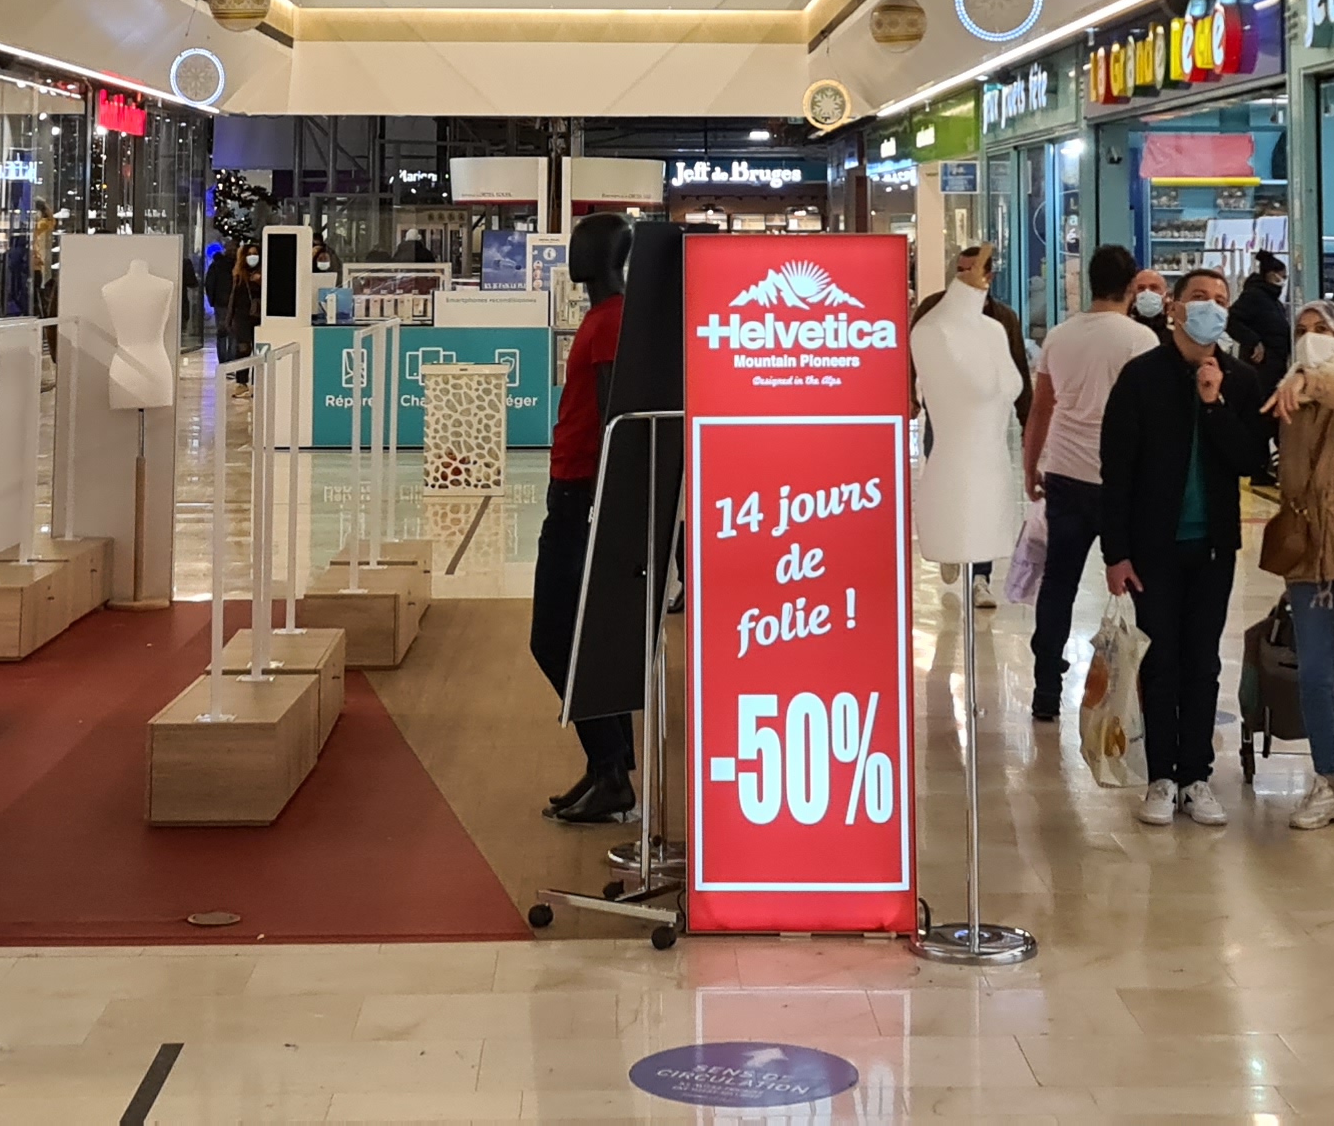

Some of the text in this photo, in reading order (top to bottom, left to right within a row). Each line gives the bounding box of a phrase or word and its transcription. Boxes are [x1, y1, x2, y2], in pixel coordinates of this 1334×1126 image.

[671, 160, 802, 188] Jeff de Bruges
[696, 312, 897, 349] Helvetica
[734, 354, 860, 368] Mountain Pioneers
[752, 375, 793, 387] Designed
[794, 375, 803, 385] in
[821, 376, 842, 387] Alps
[715, 477, 882, 539] 14 jours
[776, 543, 826, 585] de
[737, 587, 857, 659] folie !
[710, 691, 894, 826] -50%
[656, 1067, 810, 1095] CIRCULATION
[693, 1064, 753, 1079] SENS
